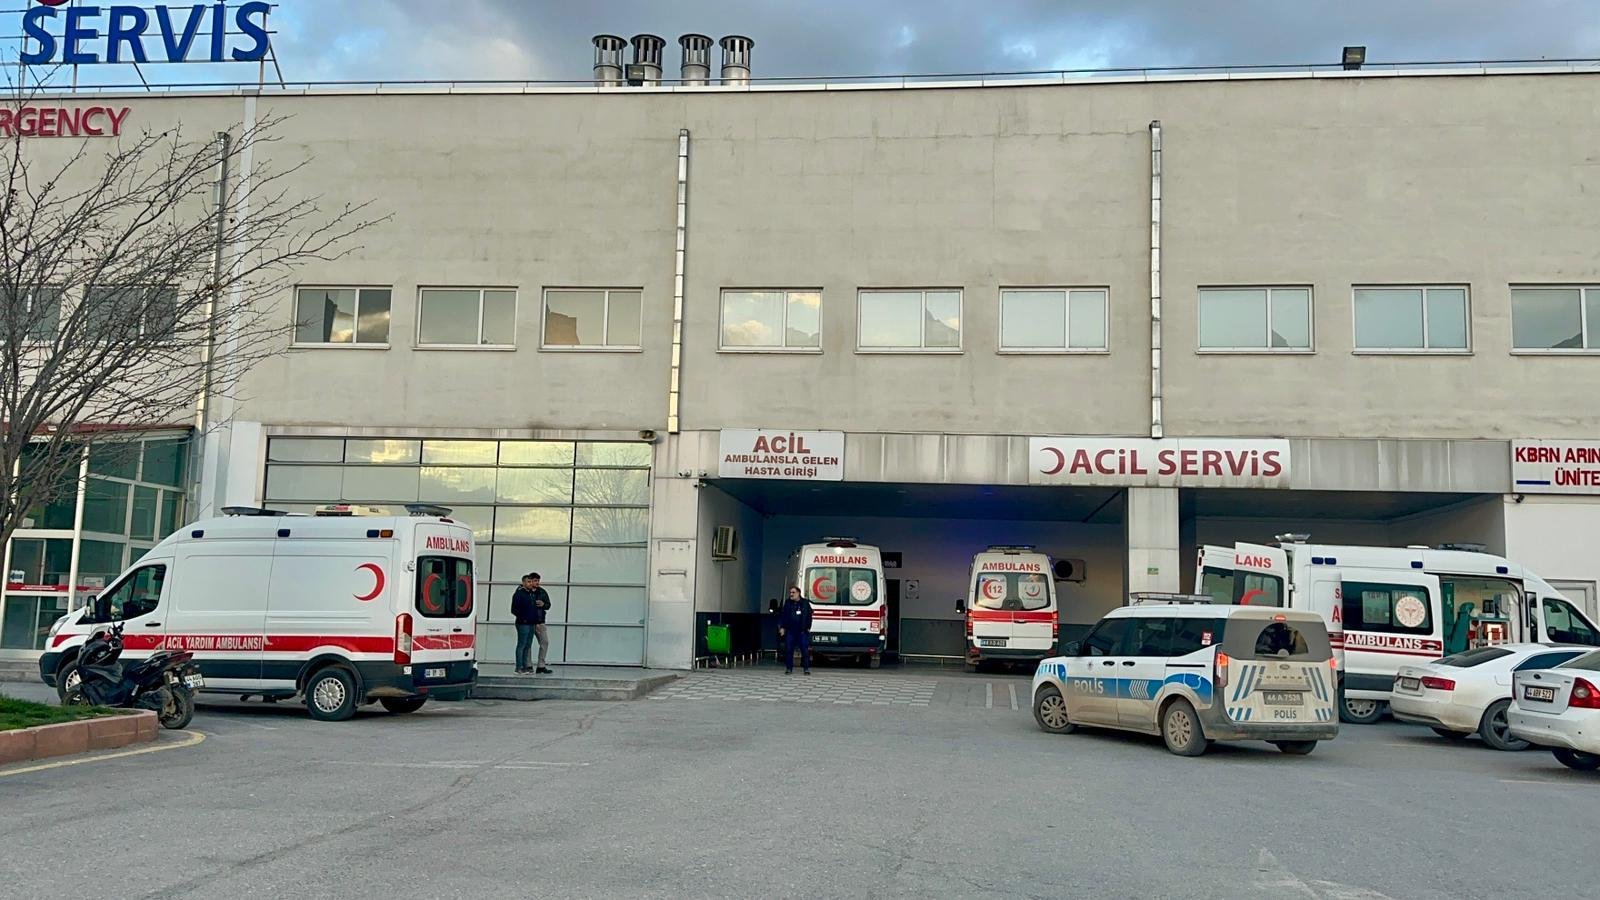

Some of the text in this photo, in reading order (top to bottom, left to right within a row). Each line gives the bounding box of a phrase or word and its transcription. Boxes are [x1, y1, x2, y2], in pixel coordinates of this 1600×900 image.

[752, 432, 811, 454] ACİL
[724, 454, 838, 466] AMBULANSLA GELEN
[1515, 446, 1561, 463] KBRN
[744, 465, 818, 478] HASTA GİRİŞİ
[1555, 466, 1600, 486] ÜNİTE
[426, 535, 470, 552] AMBULANS
[813, 555, 868, 565] AMBULANS
[981, 562, 1041, 572] AMBULANS
[1235, 554, 1272, 569] LANS
[988, 585, 1003, 594] 112
[186, 636, 214, 650] YARDIM
[215, 637, 262, 651] AMBULANSI
[1345, 633, 1423, 649] AMBULANS
[1274, 706, 1297, 719] POLİS
